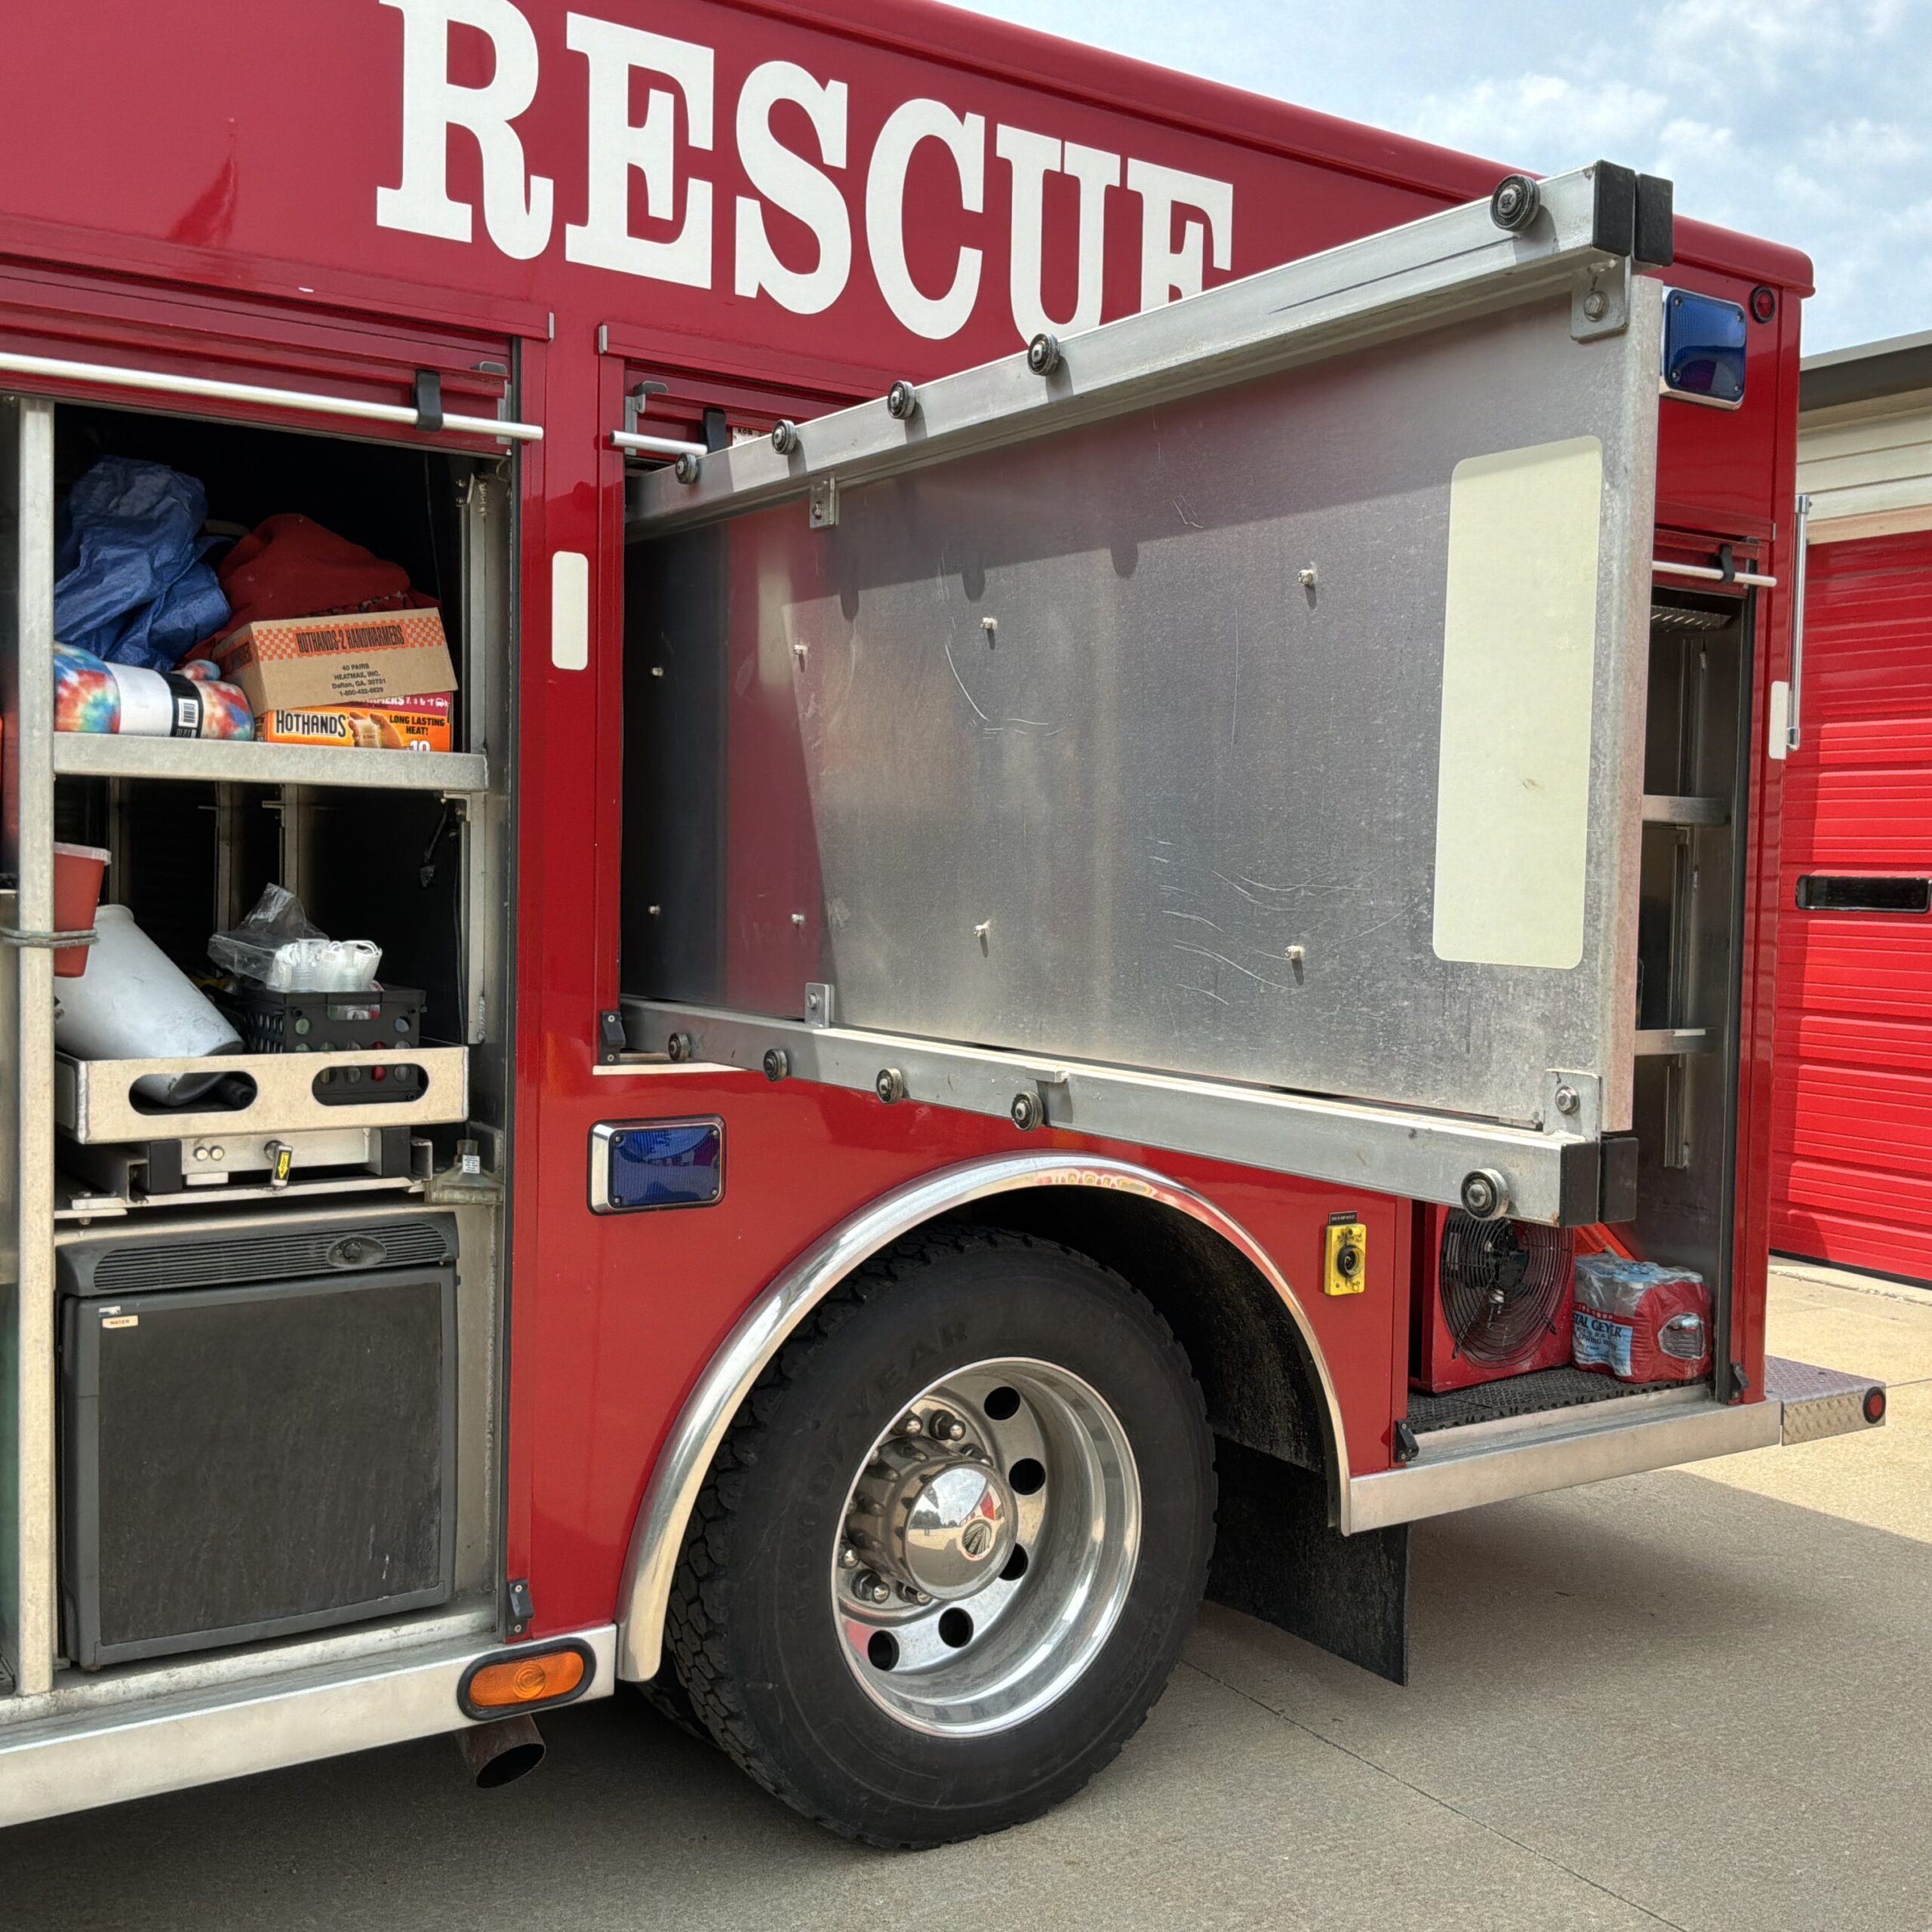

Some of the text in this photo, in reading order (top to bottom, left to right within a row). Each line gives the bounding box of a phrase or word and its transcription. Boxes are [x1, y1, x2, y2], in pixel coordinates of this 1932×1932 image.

[377, 0, 1233, 346] RESCUE
[345, 625, 405, 649] HANDWARMERS
[276, 709, 346, 738] HOTHANDS
[389, 715, 445, 727] LONG LASTING
[405, 726, 429, 736] HEAT!
